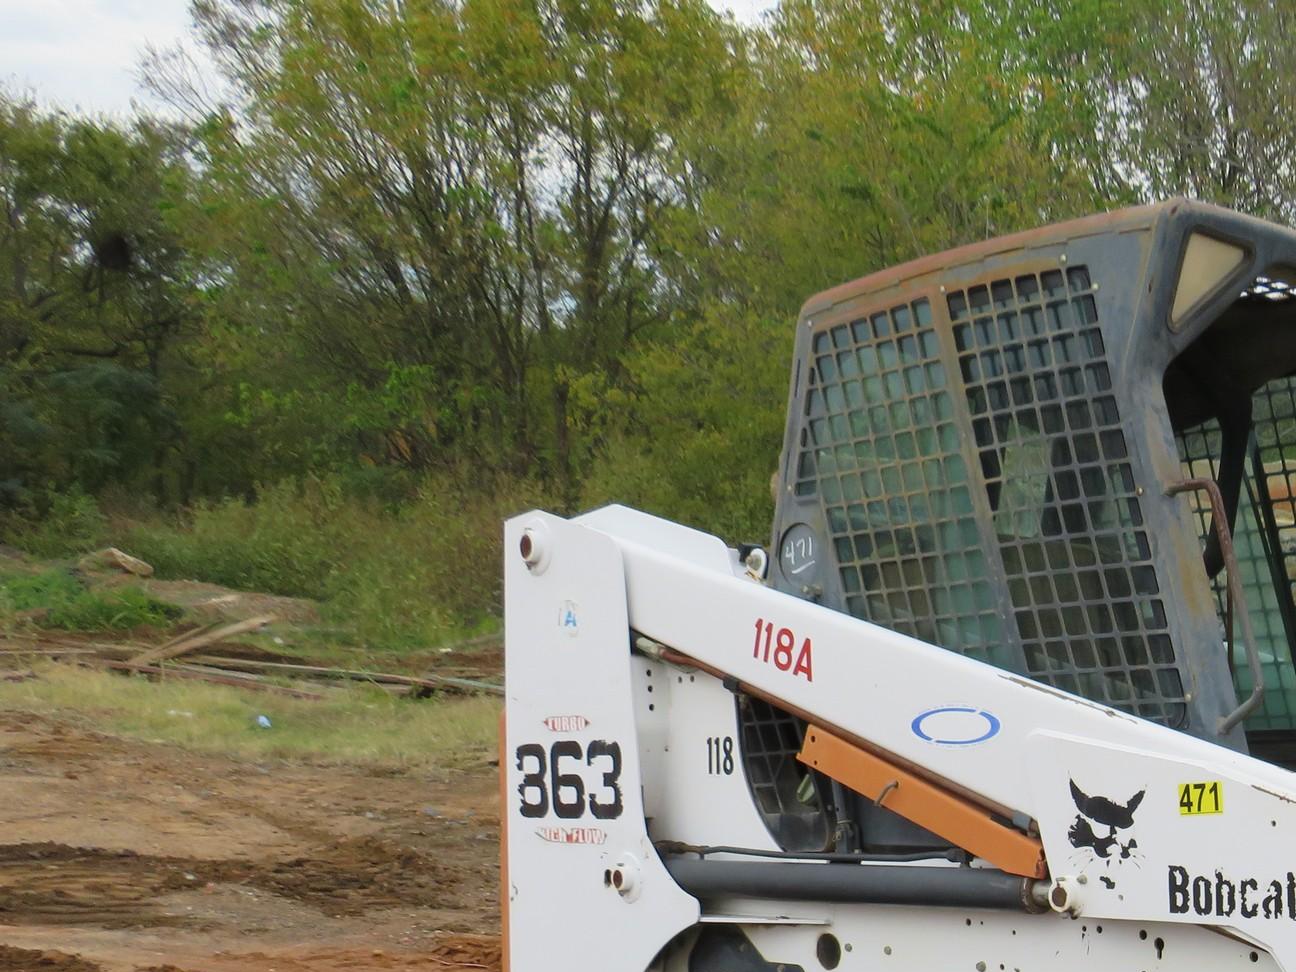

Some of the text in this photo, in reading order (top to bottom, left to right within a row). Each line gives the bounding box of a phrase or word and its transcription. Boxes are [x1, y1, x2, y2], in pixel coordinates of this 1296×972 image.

[785, 536, 813, 565] 471
[753, 618, 812, 682] 118A
[706, 736, 734, 775] 118
[516, 739, 623, 819] 863
[1179, 782, 1219, 813] 471
